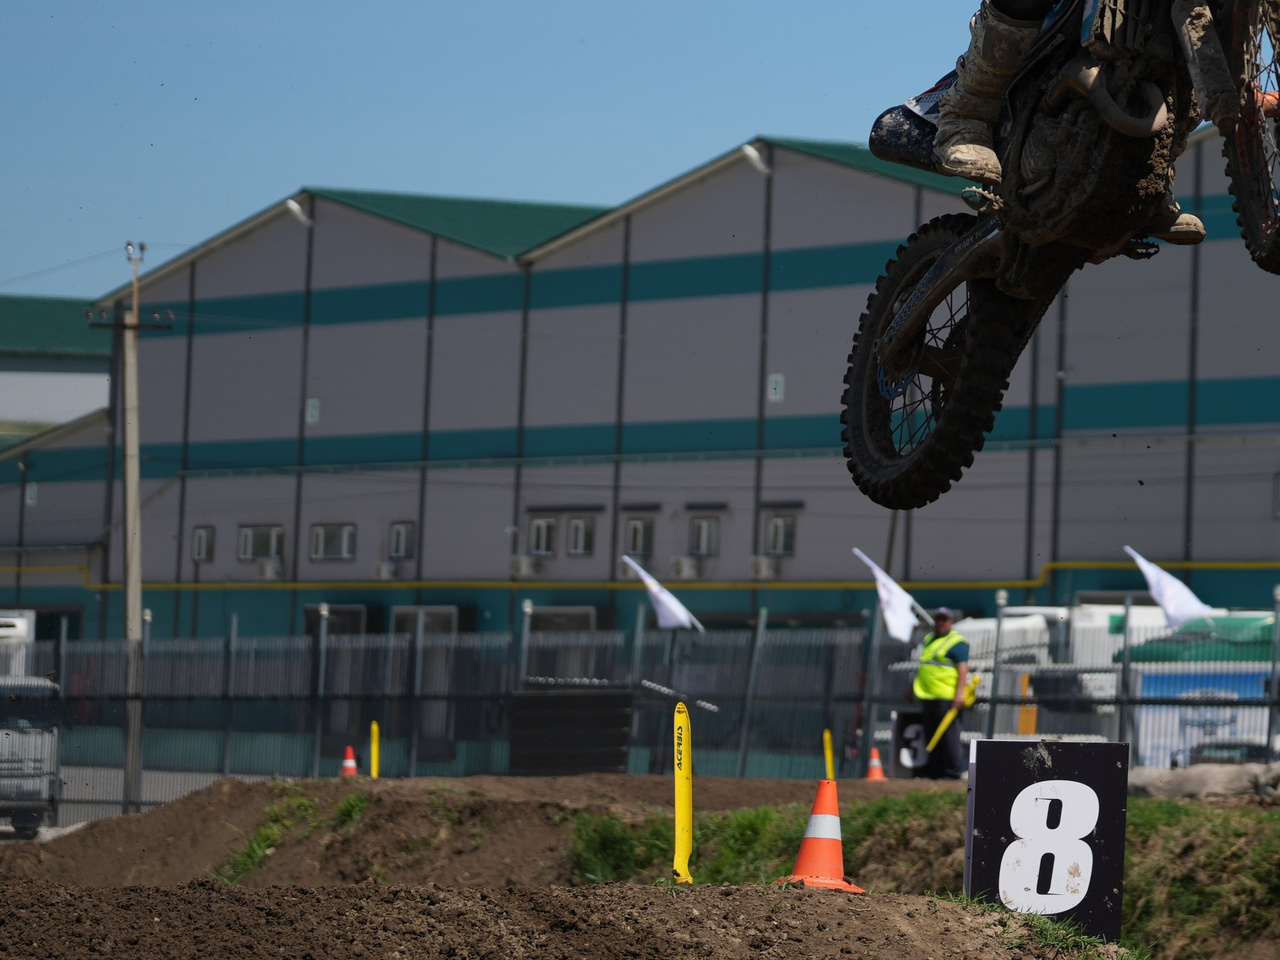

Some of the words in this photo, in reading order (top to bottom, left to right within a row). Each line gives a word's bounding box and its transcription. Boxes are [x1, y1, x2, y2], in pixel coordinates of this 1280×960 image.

[955, 236, 974, 254] READY
[900, 723, 928, 768] 3
[999, 780, 1100, 916] 8
